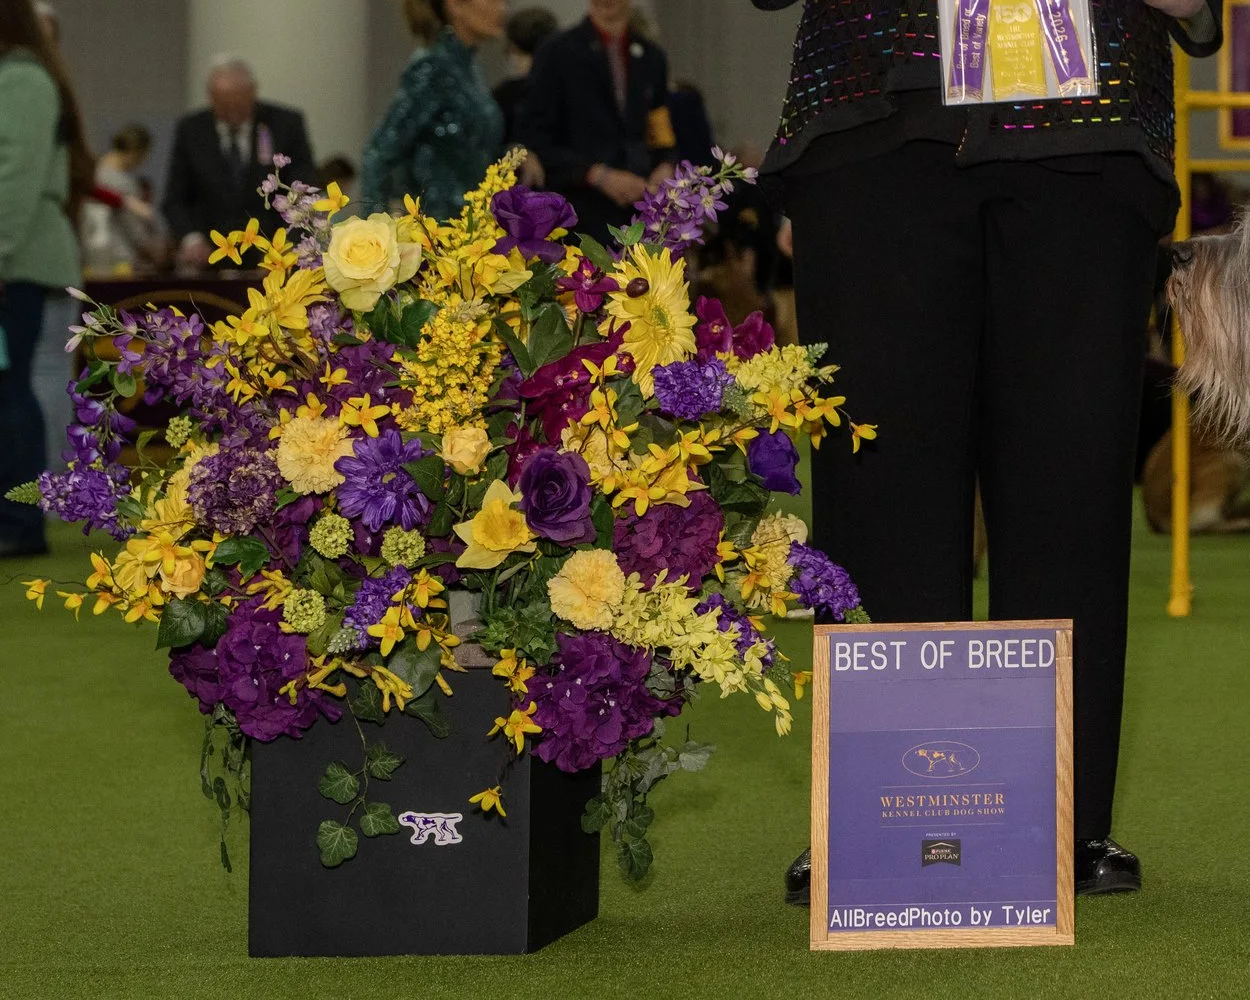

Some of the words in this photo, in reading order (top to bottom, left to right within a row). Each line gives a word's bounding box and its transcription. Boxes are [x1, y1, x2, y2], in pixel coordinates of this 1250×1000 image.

[993, 3, 1032, 24] 150
[973, 13, 987, 39] Variety
[1050, 12, 1068, 43] 2026
[973, 41, 982, 50] of
[970, 52, 981, 69] Best
[835, 640, 907, 671] BEST
[920, 640, 955, 669] OF
[968, 639, 1055, 669] BREED
[881, 793, 1005, 808] WESTMINSTER
[882, 810, 922, 818] KENNEL
[925, 809, 950, 817] CLUB
[953, 808, 975, 816] DOG
[977, 807, 1006, 816] SHOW
[830, 908, 962, 928] AllBreedPhoto
[971, 907, 993, 926] by
[1002, 905, 1051, 926] Tyler
